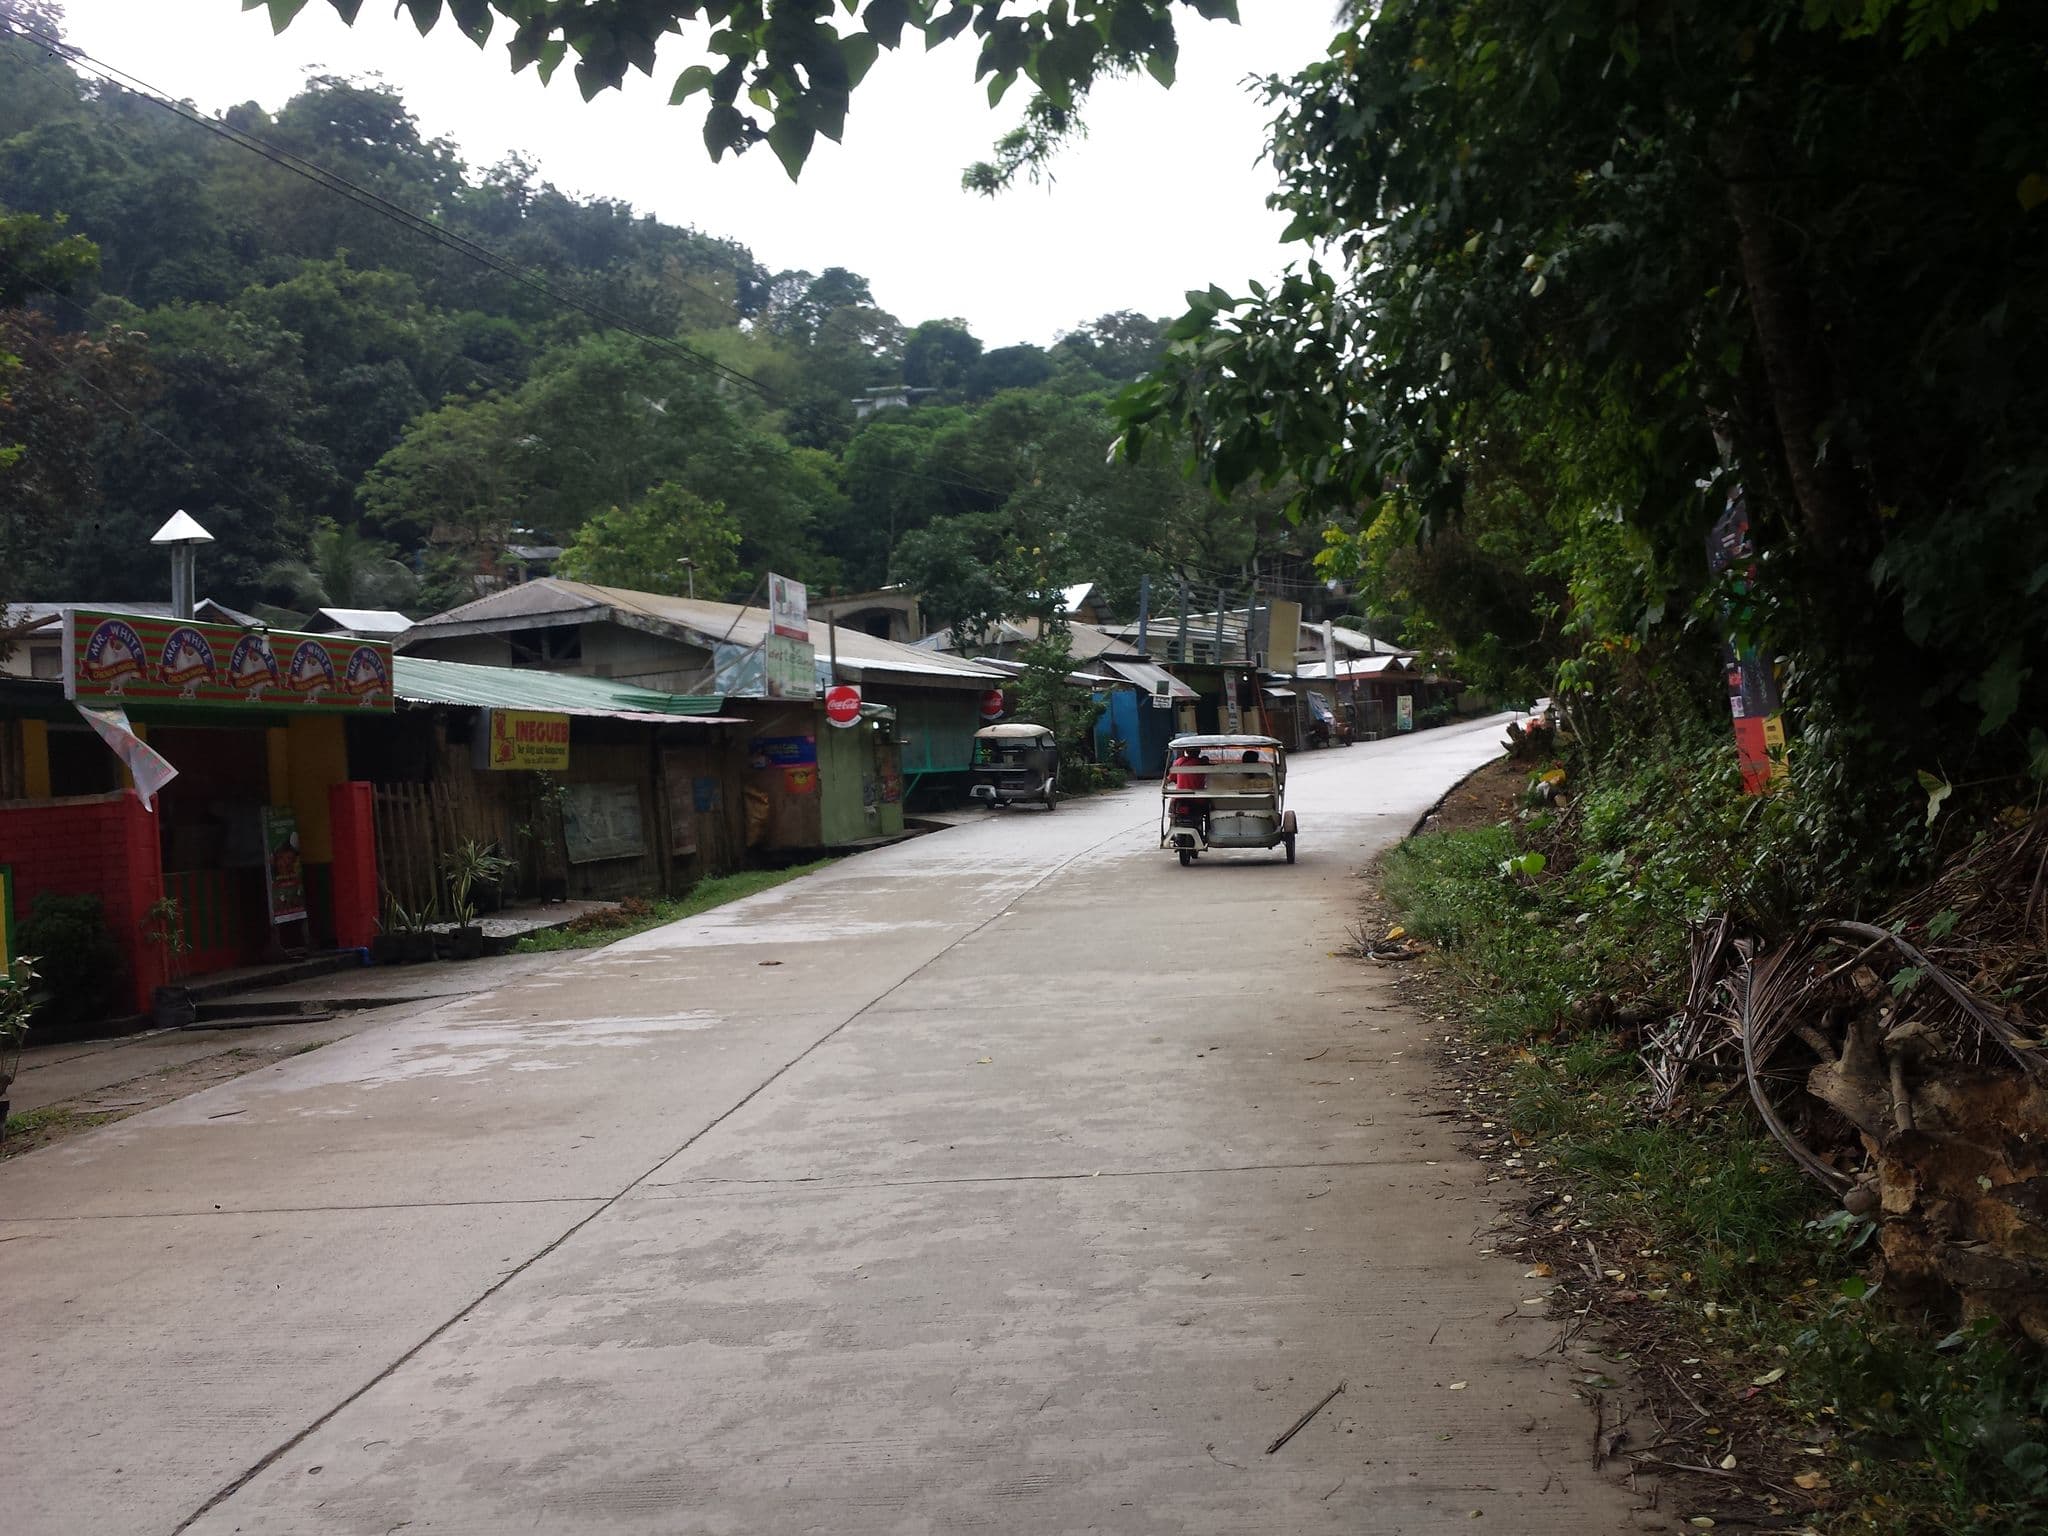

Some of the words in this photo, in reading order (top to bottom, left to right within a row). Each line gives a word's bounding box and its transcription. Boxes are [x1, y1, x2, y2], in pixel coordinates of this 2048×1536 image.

[90, 633, 108, 656] MR.
[109, 625, 142, 657] WHITE
[165, 640, 181, 661] MR.
[182, 632, 212, 664] WHITE
[828, 698, 859, 711] Coca-Cola
